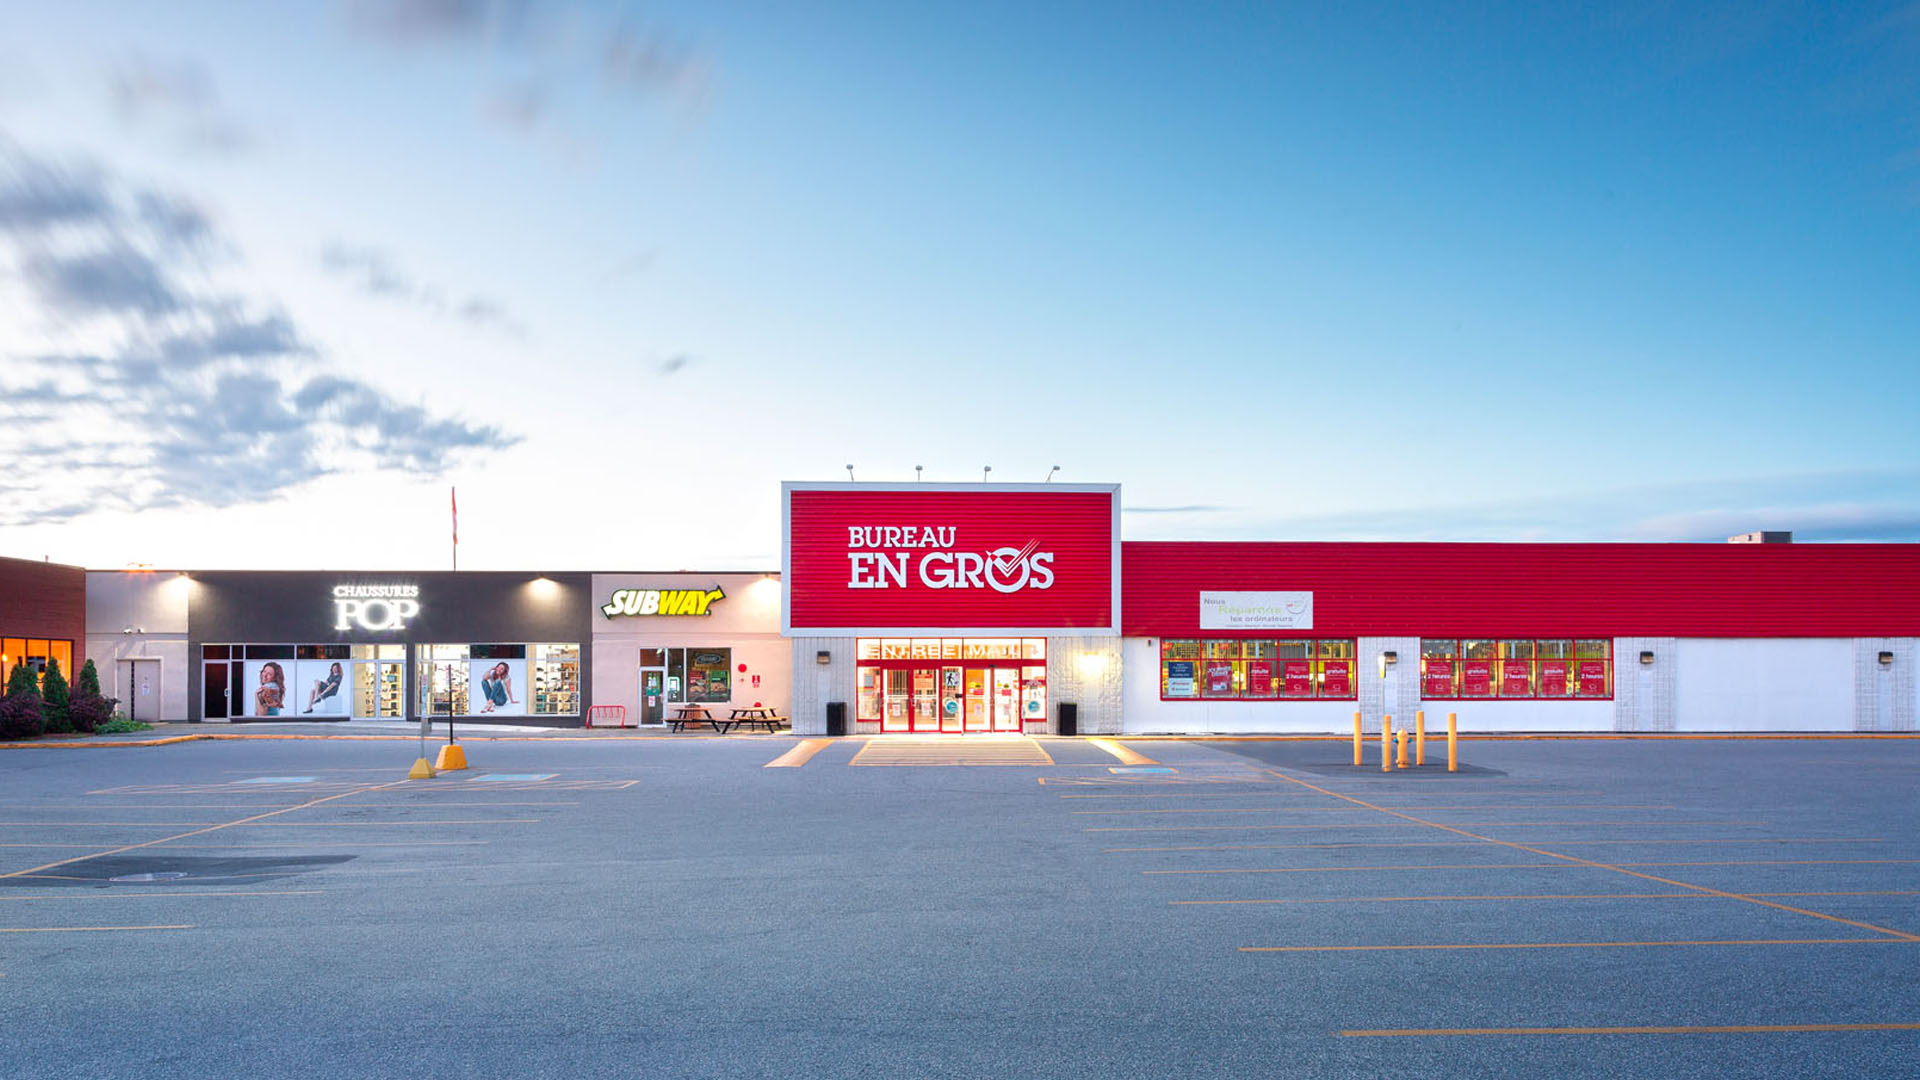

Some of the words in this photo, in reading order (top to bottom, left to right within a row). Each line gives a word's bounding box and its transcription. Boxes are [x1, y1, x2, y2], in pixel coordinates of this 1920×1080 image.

[848, 526, 956, 548] BUREAU
[848, 552, 910, 588] EN
[919, 547, 1055, 593] GROS
[333, 585, 419, 597] CHAUSSURES
[602, 588, 725, 618] SUBWAY
[333, 599, 420, 630] POP
